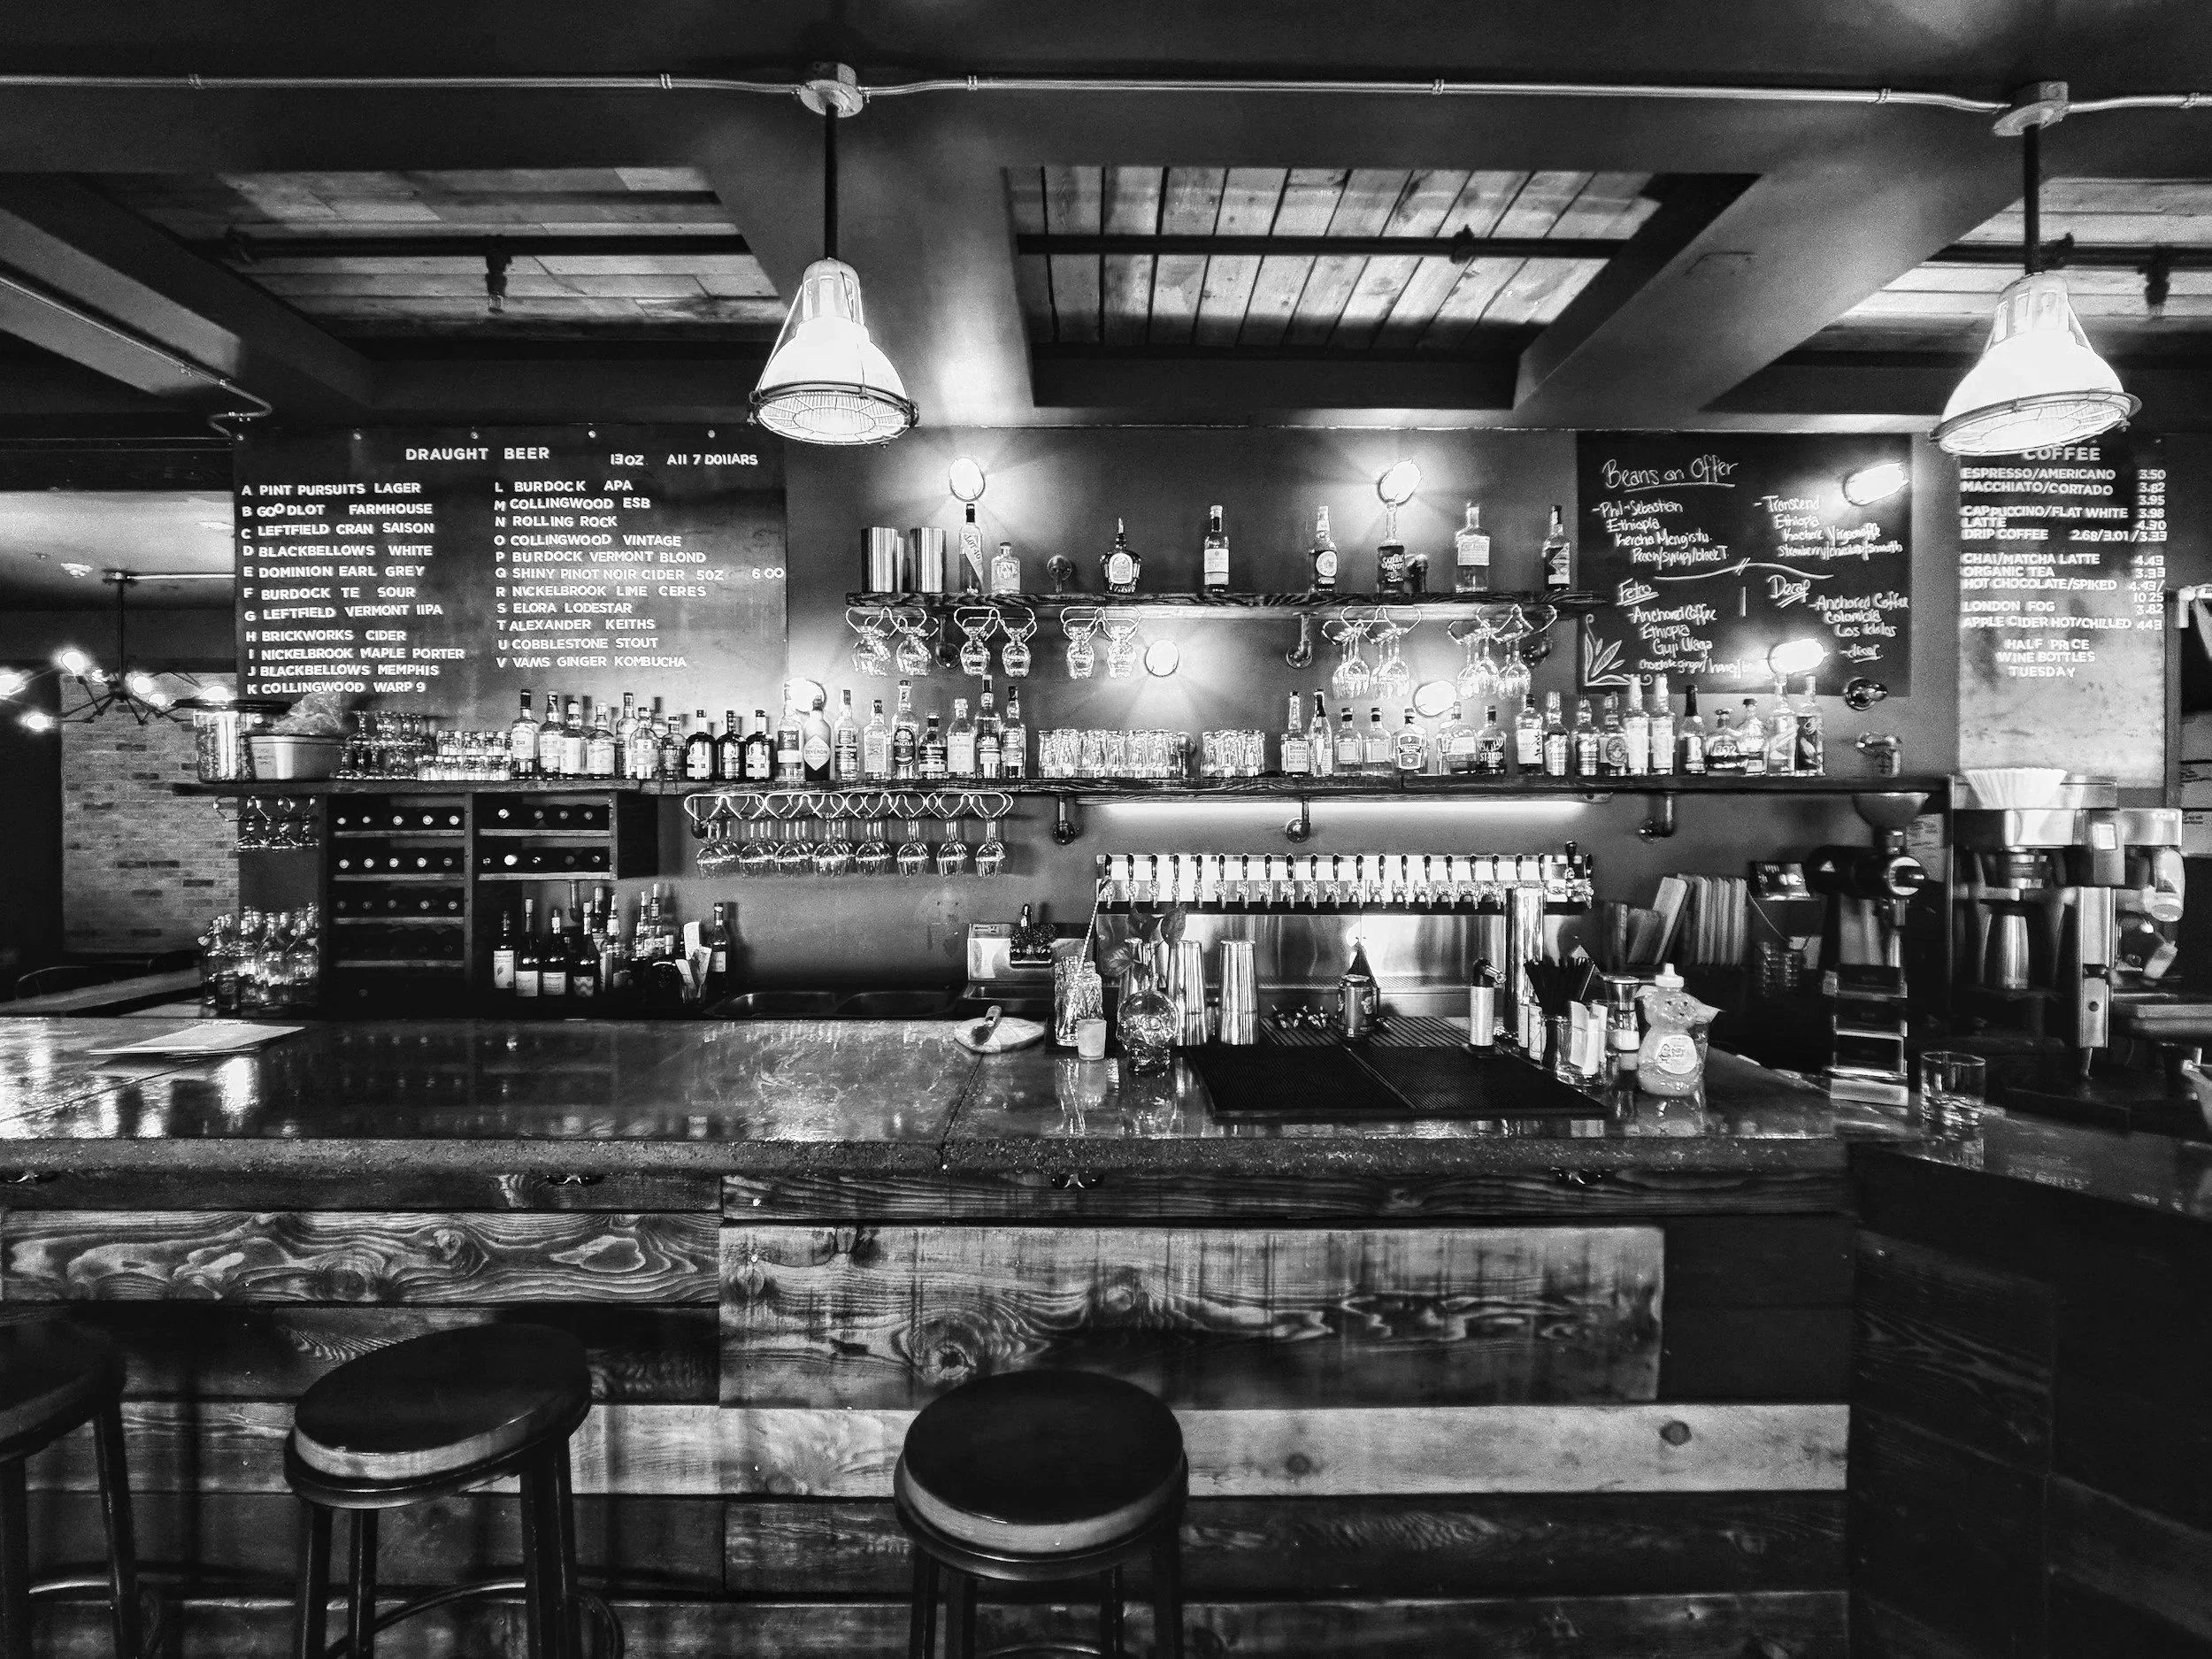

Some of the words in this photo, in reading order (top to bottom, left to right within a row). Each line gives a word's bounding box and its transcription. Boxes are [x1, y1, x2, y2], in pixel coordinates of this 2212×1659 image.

[406, 448, 488, 460] DRAUGHT
[504, 447, 549, 459] BEER
[693, 455, 700, 465] 7
[2022, 447, 2101, 461] COFFEE
[1602, 459, 1659, 488] Beans
[1664, 469, 1685, 480] on
[1691, 455, 1739, 483] Offer
[1961, 468, 2116, 480] ESPRESSO/AMERICANO
[2139, 470, 2166, 480] 3.50
[242, 485, 252, 495] A
[260, 485, 291, 495] PINT
[298, 483, 365, 495] PURSUITS
[374, 482, 421, 494] LAGER
[495, 482, 503, 492] L
[514, 480, 586, 492] BURDOCK
[604, 480, 633, 491] APA
[1960, 481, 2113, 495] MACCHIATO/CORTADO
[2139, 482, 2165, 494] 3.82
[494, 500, 505, 511] M
[510, 497, 614, 510] COLLINGWOOD
[623, 497, 650, 508] ESB
[2139, 495, 2165, 505] 3.95
[242, 506, 252, 517] B
[257, 503, 325, 517] GOODLOT
[349, 503, 433, 515] FARMHOUSE
[1960, 505, 2083, 518] CAPPUCCINO/FLAT
[2085, 508, 2128, 518] WHITE
[2139, 508, 2164, 518] 3.98
[495, 516, 505, 527] N
[513, 516, 573, 527] ROLLING
[580, 516, 617, 527] ROCK
[1606, 517, 1661, 534] Ethiopia
[1773, 513, 1819, 529] Ethiopia
[1961, 517, 2006, 528] LATTE
[2135, 520, 2167, 530] 4.30
[242, 528, 251, 539] C
[257, 524, 329, 536] LEFTFIELD
[336, 524, 373, 534] CRAN
[382, 523, 434, 534] SAISON
[1961, 529, 1994, 540] DRIP
[1997, 528, 2048, 540] COFFEE
[494, 535, 505, 546] O
[511, 534, 611, 546] COLLINGWOOD
[623, 535, 681, 547] VINTAGE
[242, 546, 253, 556] D
[258, 545, 375, 557] BLACKBELLOWS
[388, 545, 433, 556] WHITE
[495, 551, 505, 562] P
[512, 551, 582, 563] BURDOCK
[589, 551, 653, 563] VERMONT
[660, 551, 706, 564] BLOND
[1961, 553, 2056, 565] CHAI/MATCHA
[2058, 553, 2100, 565] LATTE
[2133, 556, 2163, 565] 4.43
[243, 566, 253, 577] E
[259, 566, 333, 578] DOMINION
[339, 566, 376, 576] EARL
[385, 565, 425, 577] GREY
[495, 567, 506, 578] Q
[512, 568, 555, 579] SHINY
[561, 569, 599, 580] PINOT
[603, 569, 636, 580] NOIR
[641, 570, 684, 581] CIDER
[1960, 566, 2024, 577] ORGANIC
[2027, 566, 2055, 577] TEA
[2135, 567, 2165, 579] 3.33
[1961, 578, 1990, 589] HOT
[1991, 578, 2116, 590] CHOCOLATE/SPIKED
[243, 588, 253, 598] F
[261, 588, 330, 600] BURDOCK
[341, 588, 359, 598] TE
[377, 588, 415, 597] SOUR
[496, 587, 505, 597] R
[512, 586, 606, 597] NICKELBROOK
[617, 586, 647, 597] LIME
[659, 586, 706, 597] CERES
[244, 611, 256, 621] G
[263, 607, 335, 619] LEFTFIELD
[344, 605, 409, 617] VERMONT
[497, 603, 506, 613] S
[513, 603, 557, 613] ELORA
[565, 603, 632, 613] LODESTAR
[1961, 601, 2020, 612] LONDON
[2026, 601, 2055, 611] FOG
[497, 620, 506, 630] T
[509, 619, 591, 631] ALEXANDER
[605, 618, 655, 630] KEITHS
[1961, 617, 2004, 628] APPLE
[2007, 616, 2048, 628] CIDER
[2051, 617, 2131, 629] HOT/CHILLED
[246, 631, 257, 641] H
[262, 630, 354, 641] BRICKWORKS
[365, 630, 406, 641] CIDER
[1640, 624, 1690, 640] Ethiopia
[498, 640, 508, 649] U
[511, 638, 608, 650] COBBLESTONE
[616, 637, 658, 649] STOUT
[2004, 639, 2042, 649] HALF
[2050, 639, 2089, 650] PRICE
[249, 649, 254, 659] I
[261, 648, 353, 660] NICKELBROOK
[360, 648, 405, 658] MAPLE
[412, 649, 465, 659] PORTER
[1997, 652, 2035, 663] WINE
[2038, 652, 2095, 663] BOTTLES
[496, 657, 507, 668] V
[512, 657, 550, 667] VAMS
[557, 657, 606, 667] GINGER
[614, 657, 687, 667] KOMBUCHA
[248, 666, 256, 676] J
[260, 664, 370, 677] BLACKBELLOWS
[378, 664, 439, 675] MEMPHIS
[2008, 666, 2076, 677] TUESDAY
[247, 684, 257, 695] K
[261, 681, 365, 694] COLLINGWOOD
[373, 681, 412, 692] WARP
[417, 681, 425, 692] 9
